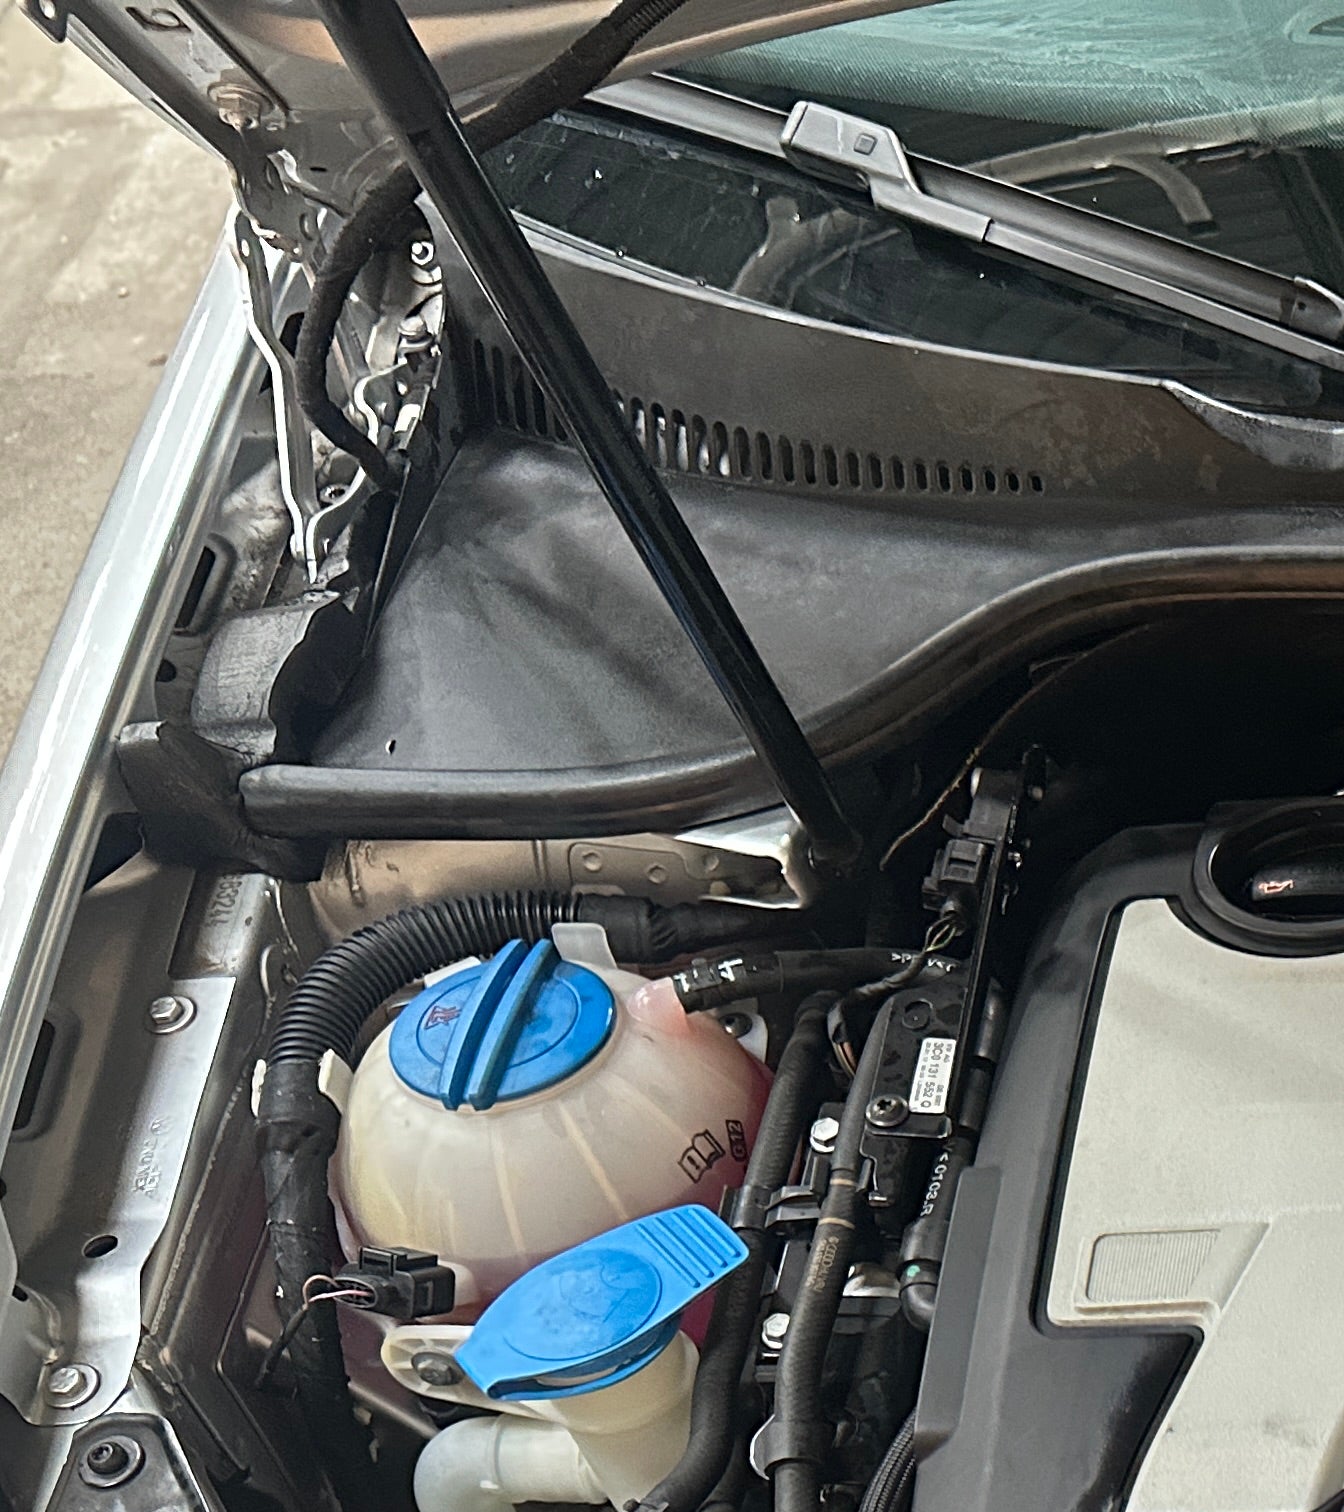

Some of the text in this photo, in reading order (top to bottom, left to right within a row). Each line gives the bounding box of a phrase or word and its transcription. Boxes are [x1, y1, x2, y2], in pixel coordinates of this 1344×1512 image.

[931, 1041, 945, 1061] 3C0
[928, 1063, 940, 1079] 131
[922, 1081, 937, 1098] 552
[919, 1099, 932, 1109] Q
